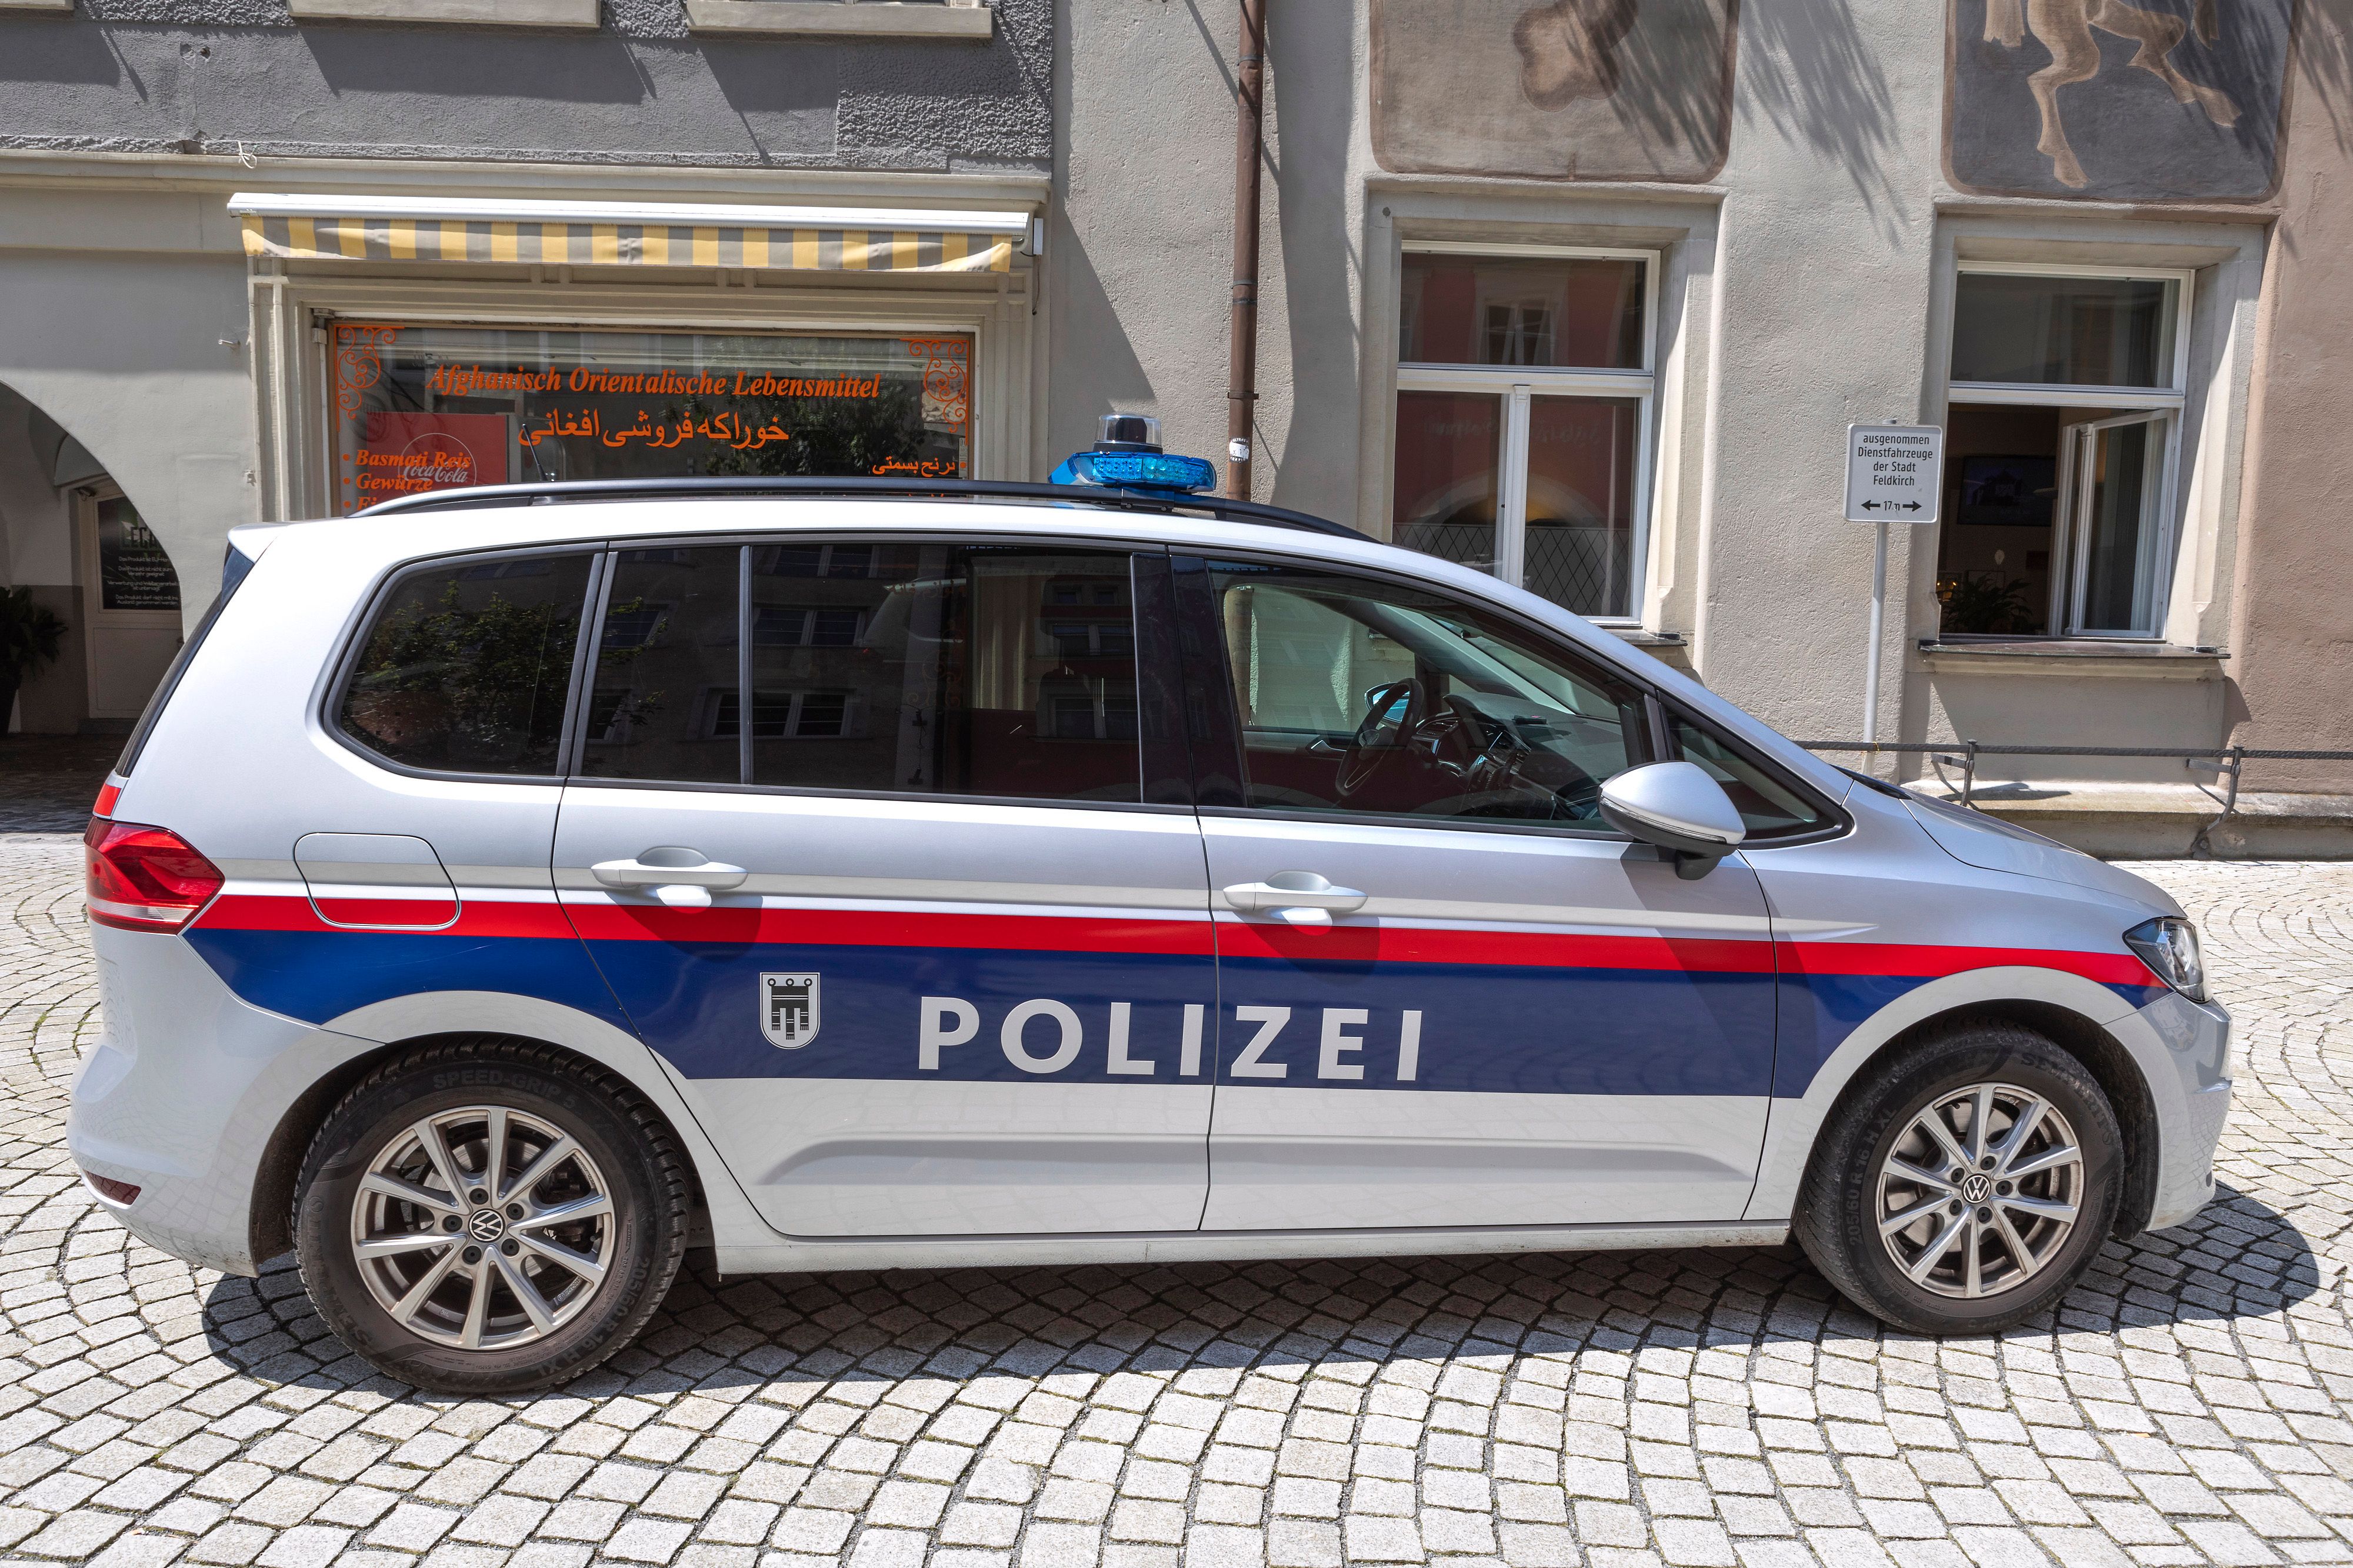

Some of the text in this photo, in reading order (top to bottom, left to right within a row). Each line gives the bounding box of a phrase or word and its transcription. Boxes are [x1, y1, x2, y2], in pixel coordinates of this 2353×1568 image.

[425, 364, 881, 398] Afghanisch Orientalische Lebensmittel
[1863, 435, 1929, 445] ausgenommen
[355, 449, 472, 469] Basmati Reis
[1858, 446, 1933, 461] Dienstfahrzeuge
[1873, 461, 1916, 472] der Stadt
[356, 472, 434, 492] Gewürze
[1873, 475, 1915, 486] Feldkirch
[1884, 501, 1892, 511] 17
[918, 996, 1422, 1082] POLIZEI
[1845, 1188, 1864, 1246] 205/60
[1856, 1148, 1871, 1169] 16
